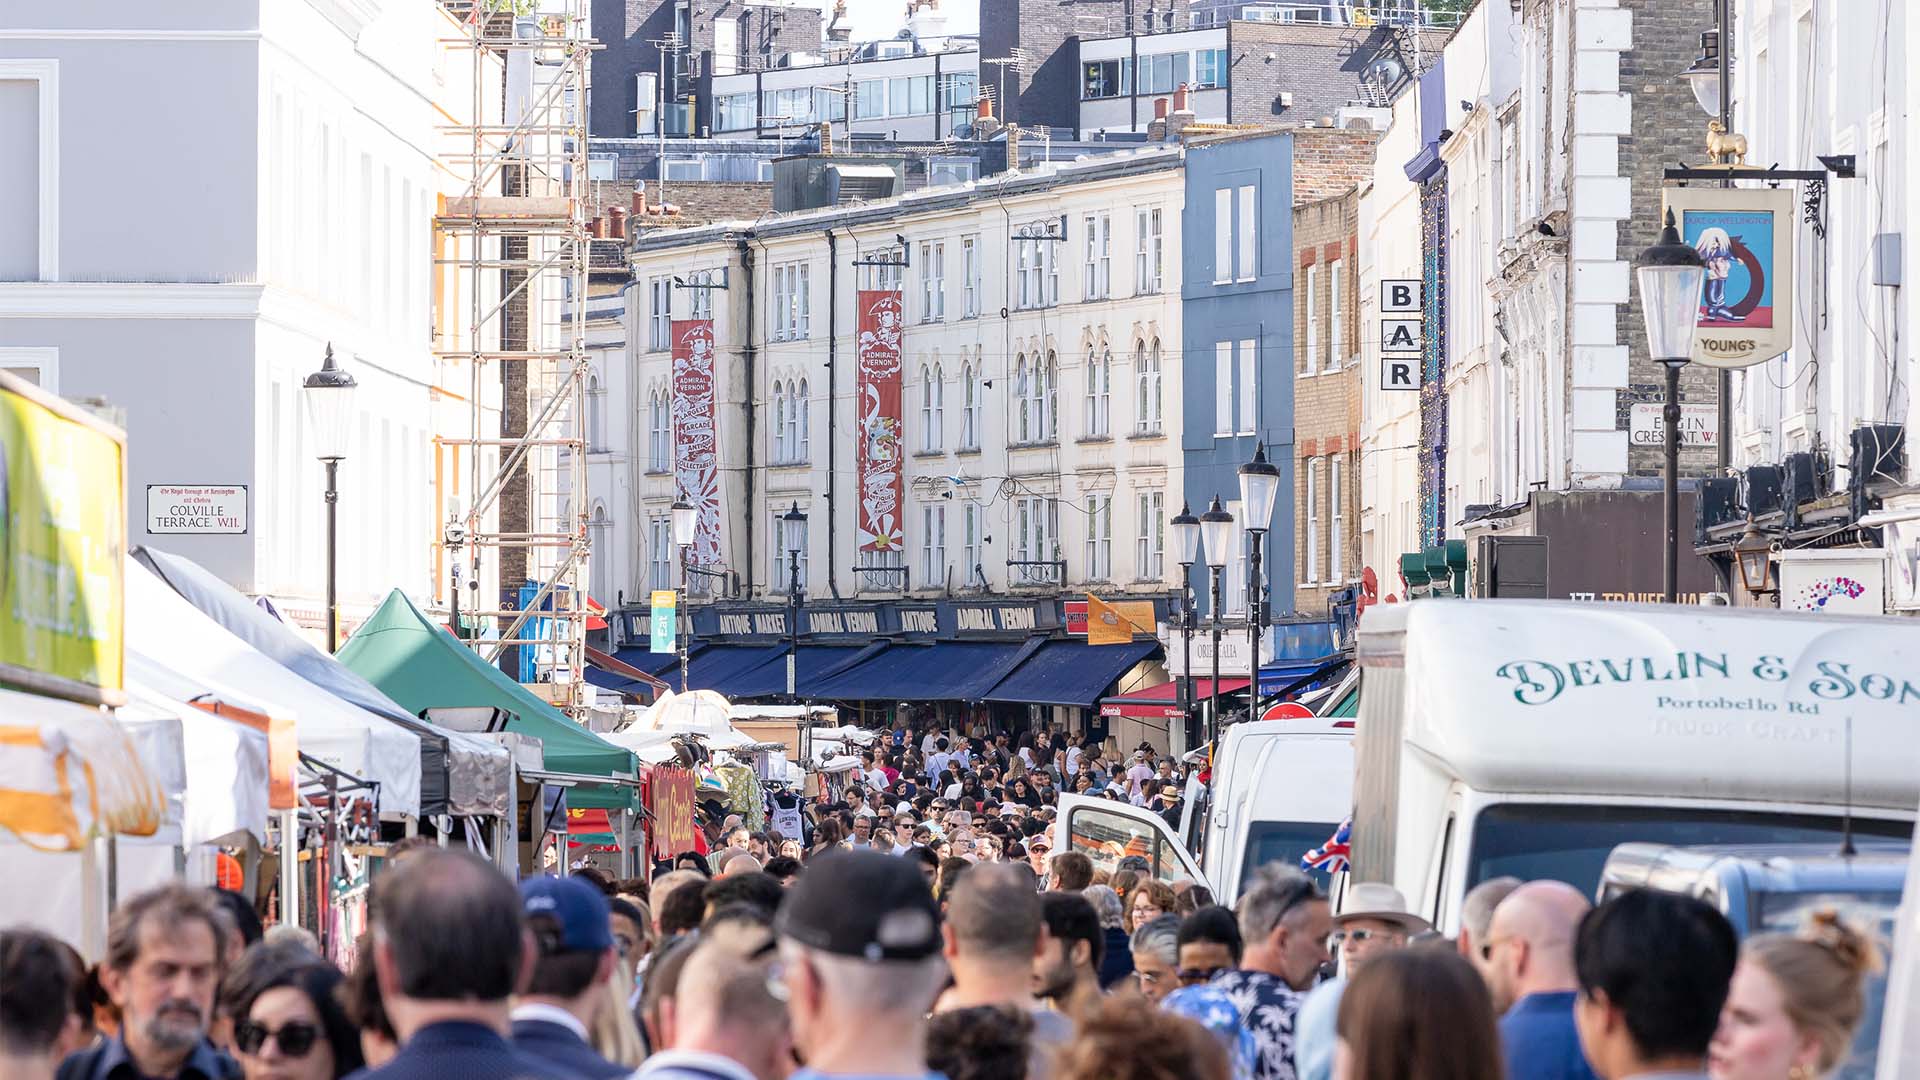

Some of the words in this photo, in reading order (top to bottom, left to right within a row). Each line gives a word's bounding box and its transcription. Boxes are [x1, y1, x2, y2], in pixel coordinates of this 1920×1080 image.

[1392, 285, 1414, 385] BAR
[1701, 338, 1756, 351] YOUNG'S
[680, 405, 707, 420] LARGEST
[685, 421, 711, 431] ARCADE
[1654, 417, 1704, 429] EGIN
[169, 505, 224, 516] COLVILLE
[656, 616, 668, 638] Eat
[719, 614, 752, 636] ANTIQUE
[754, 614, 786, 633] MARKET
[809, 612, 844, 632] ADMIRAL
[844, 612, 878, 632] VERNON
[901, 611, 938, 634] ANTIQUE
[957, 608, 996, 630] ADMIRAL
[999, 608, 1036, 630] VERNON
[1197, 644, 1237, 658] ORIETALIA
[1496, 652, 1729, 706] DEVLIN
[1752, 655, 1790, 682] &
[1656, 696, 1777, 712] Portobello
[1787, 701, 1820, 715] Rd
